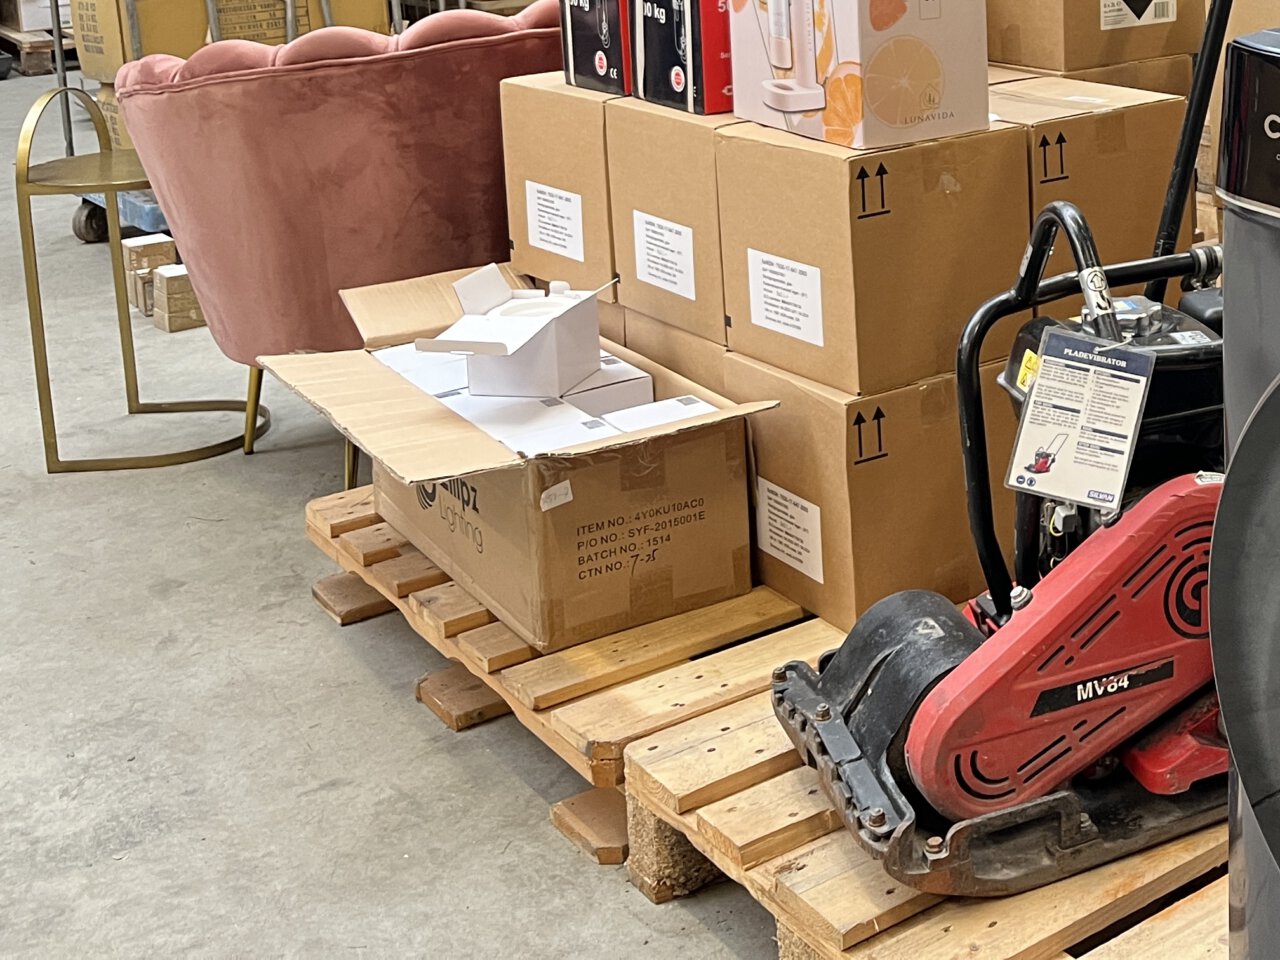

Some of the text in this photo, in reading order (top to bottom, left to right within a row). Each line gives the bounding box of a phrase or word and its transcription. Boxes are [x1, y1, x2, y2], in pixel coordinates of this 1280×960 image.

[654, 3, 666, 24] kg
[904, 111, 955, 125] LUNAVIDA
[1064, 348, 1127, 368] PLADEVIBRATOR
[576, 520, 605, 537] ITEM
[577, 537, 599, 551] P/O
[578, 548, 617, 566] BATCH
[647, 533, 671, 548] 1514
[578, 566, 603, 581] CTN
[1076, 673, 1129, 702] MV84
